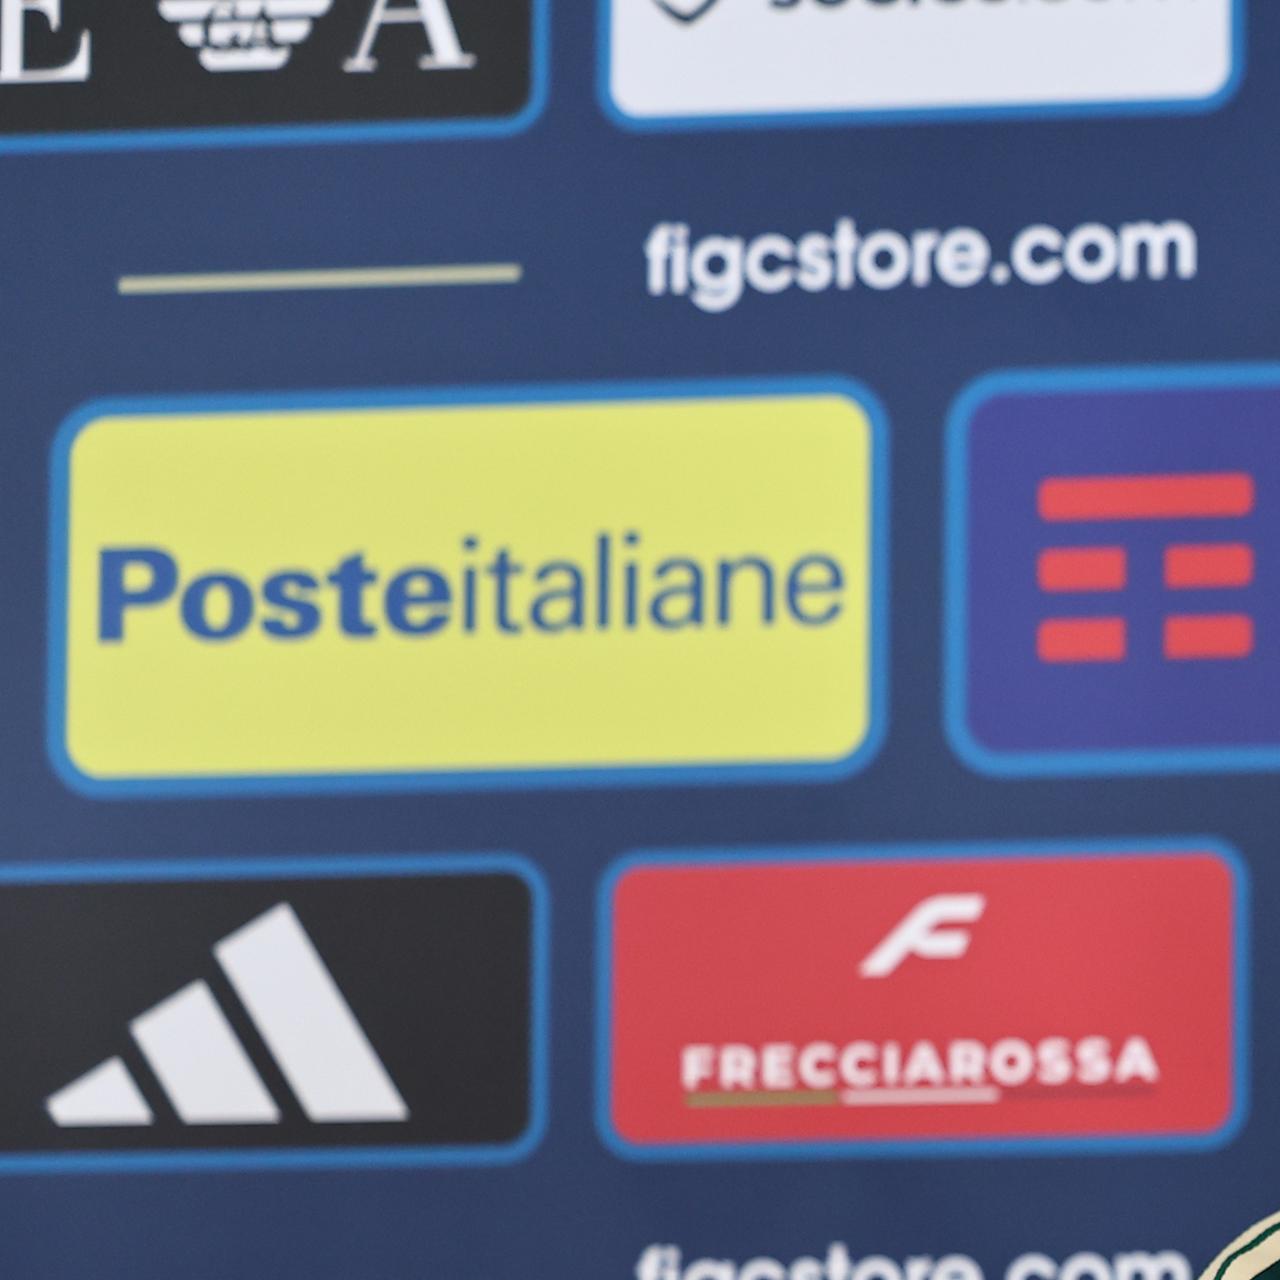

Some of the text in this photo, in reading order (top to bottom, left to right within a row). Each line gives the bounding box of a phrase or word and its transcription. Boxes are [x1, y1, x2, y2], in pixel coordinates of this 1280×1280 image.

[644, 215, 1197, 313] figcstore.com
[97, 530, 845, 645] Posteitaliane
[680, 1035, 1160, 1092] FRECCIAROSSA
